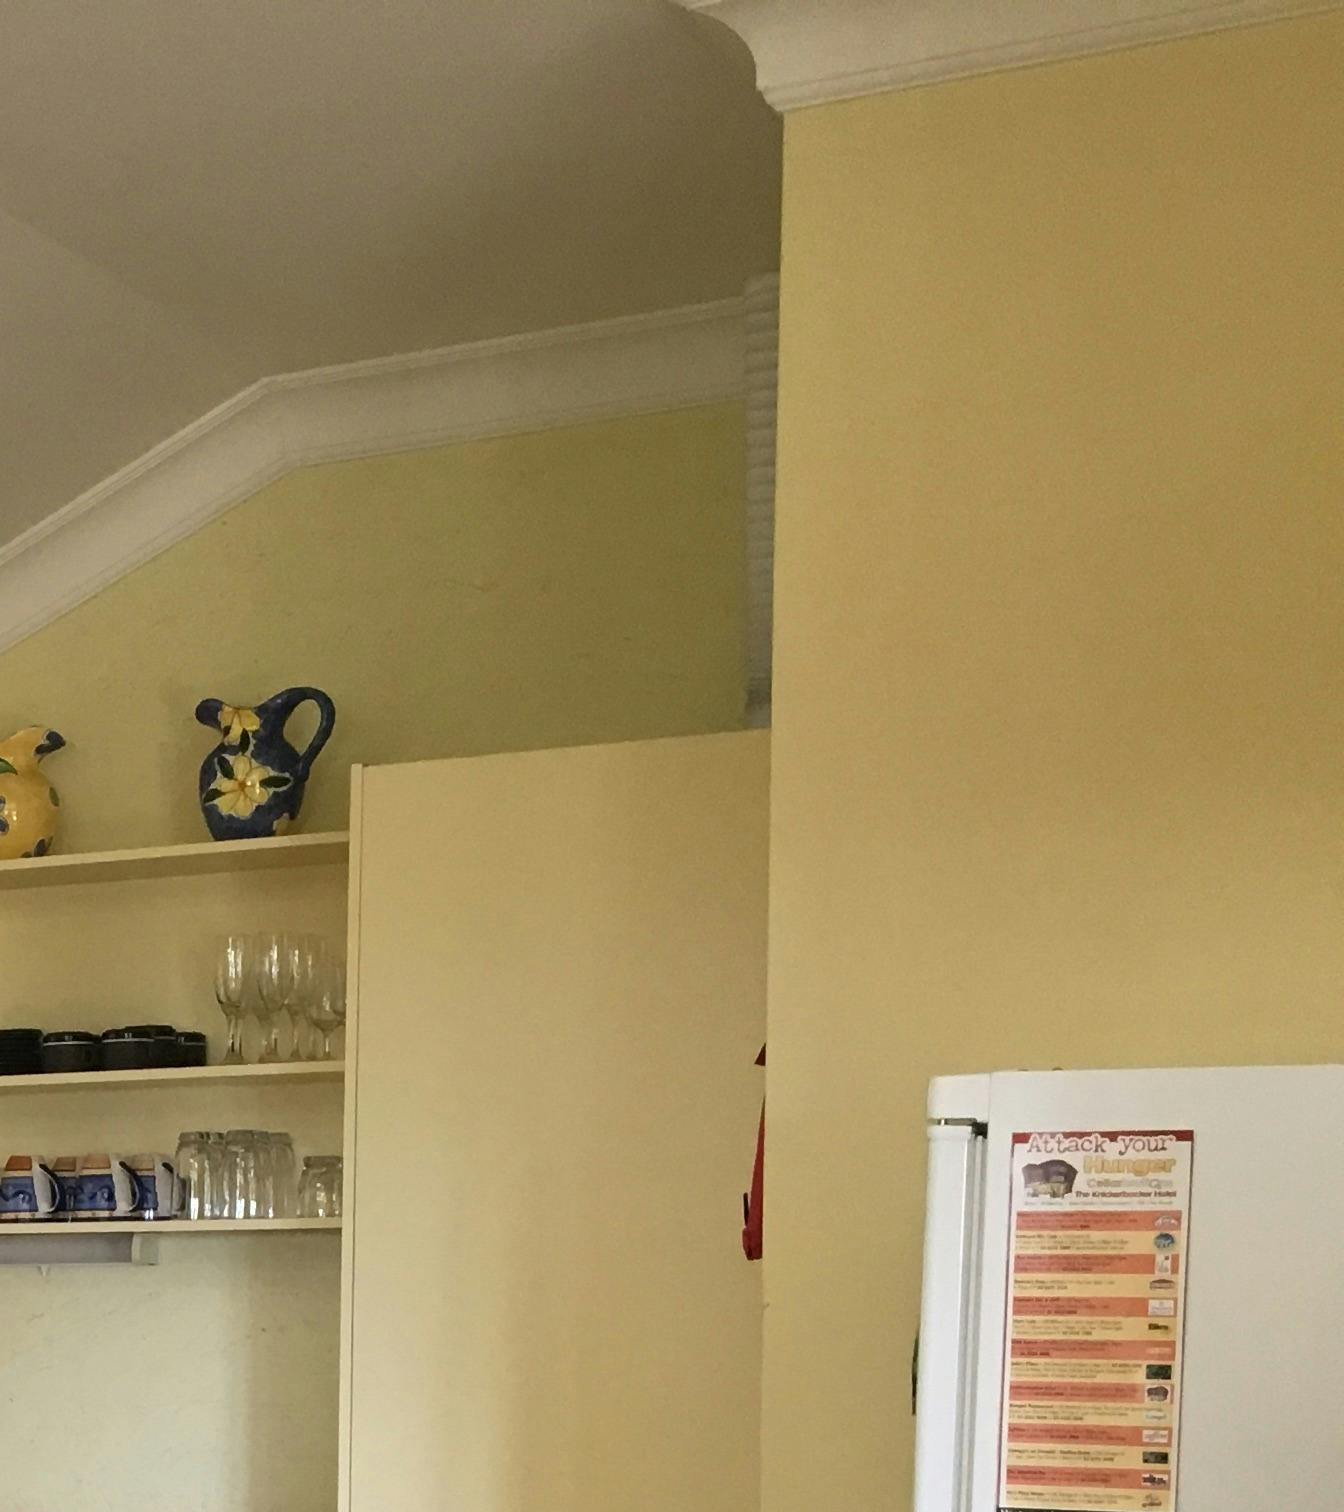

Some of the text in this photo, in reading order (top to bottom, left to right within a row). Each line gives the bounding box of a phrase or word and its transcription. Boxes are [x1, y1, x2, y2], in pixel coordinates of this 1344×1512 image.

[1027, 1134, 1175, 1156] Attack your
[1083, 1155, 1177, 1177] Hunger
